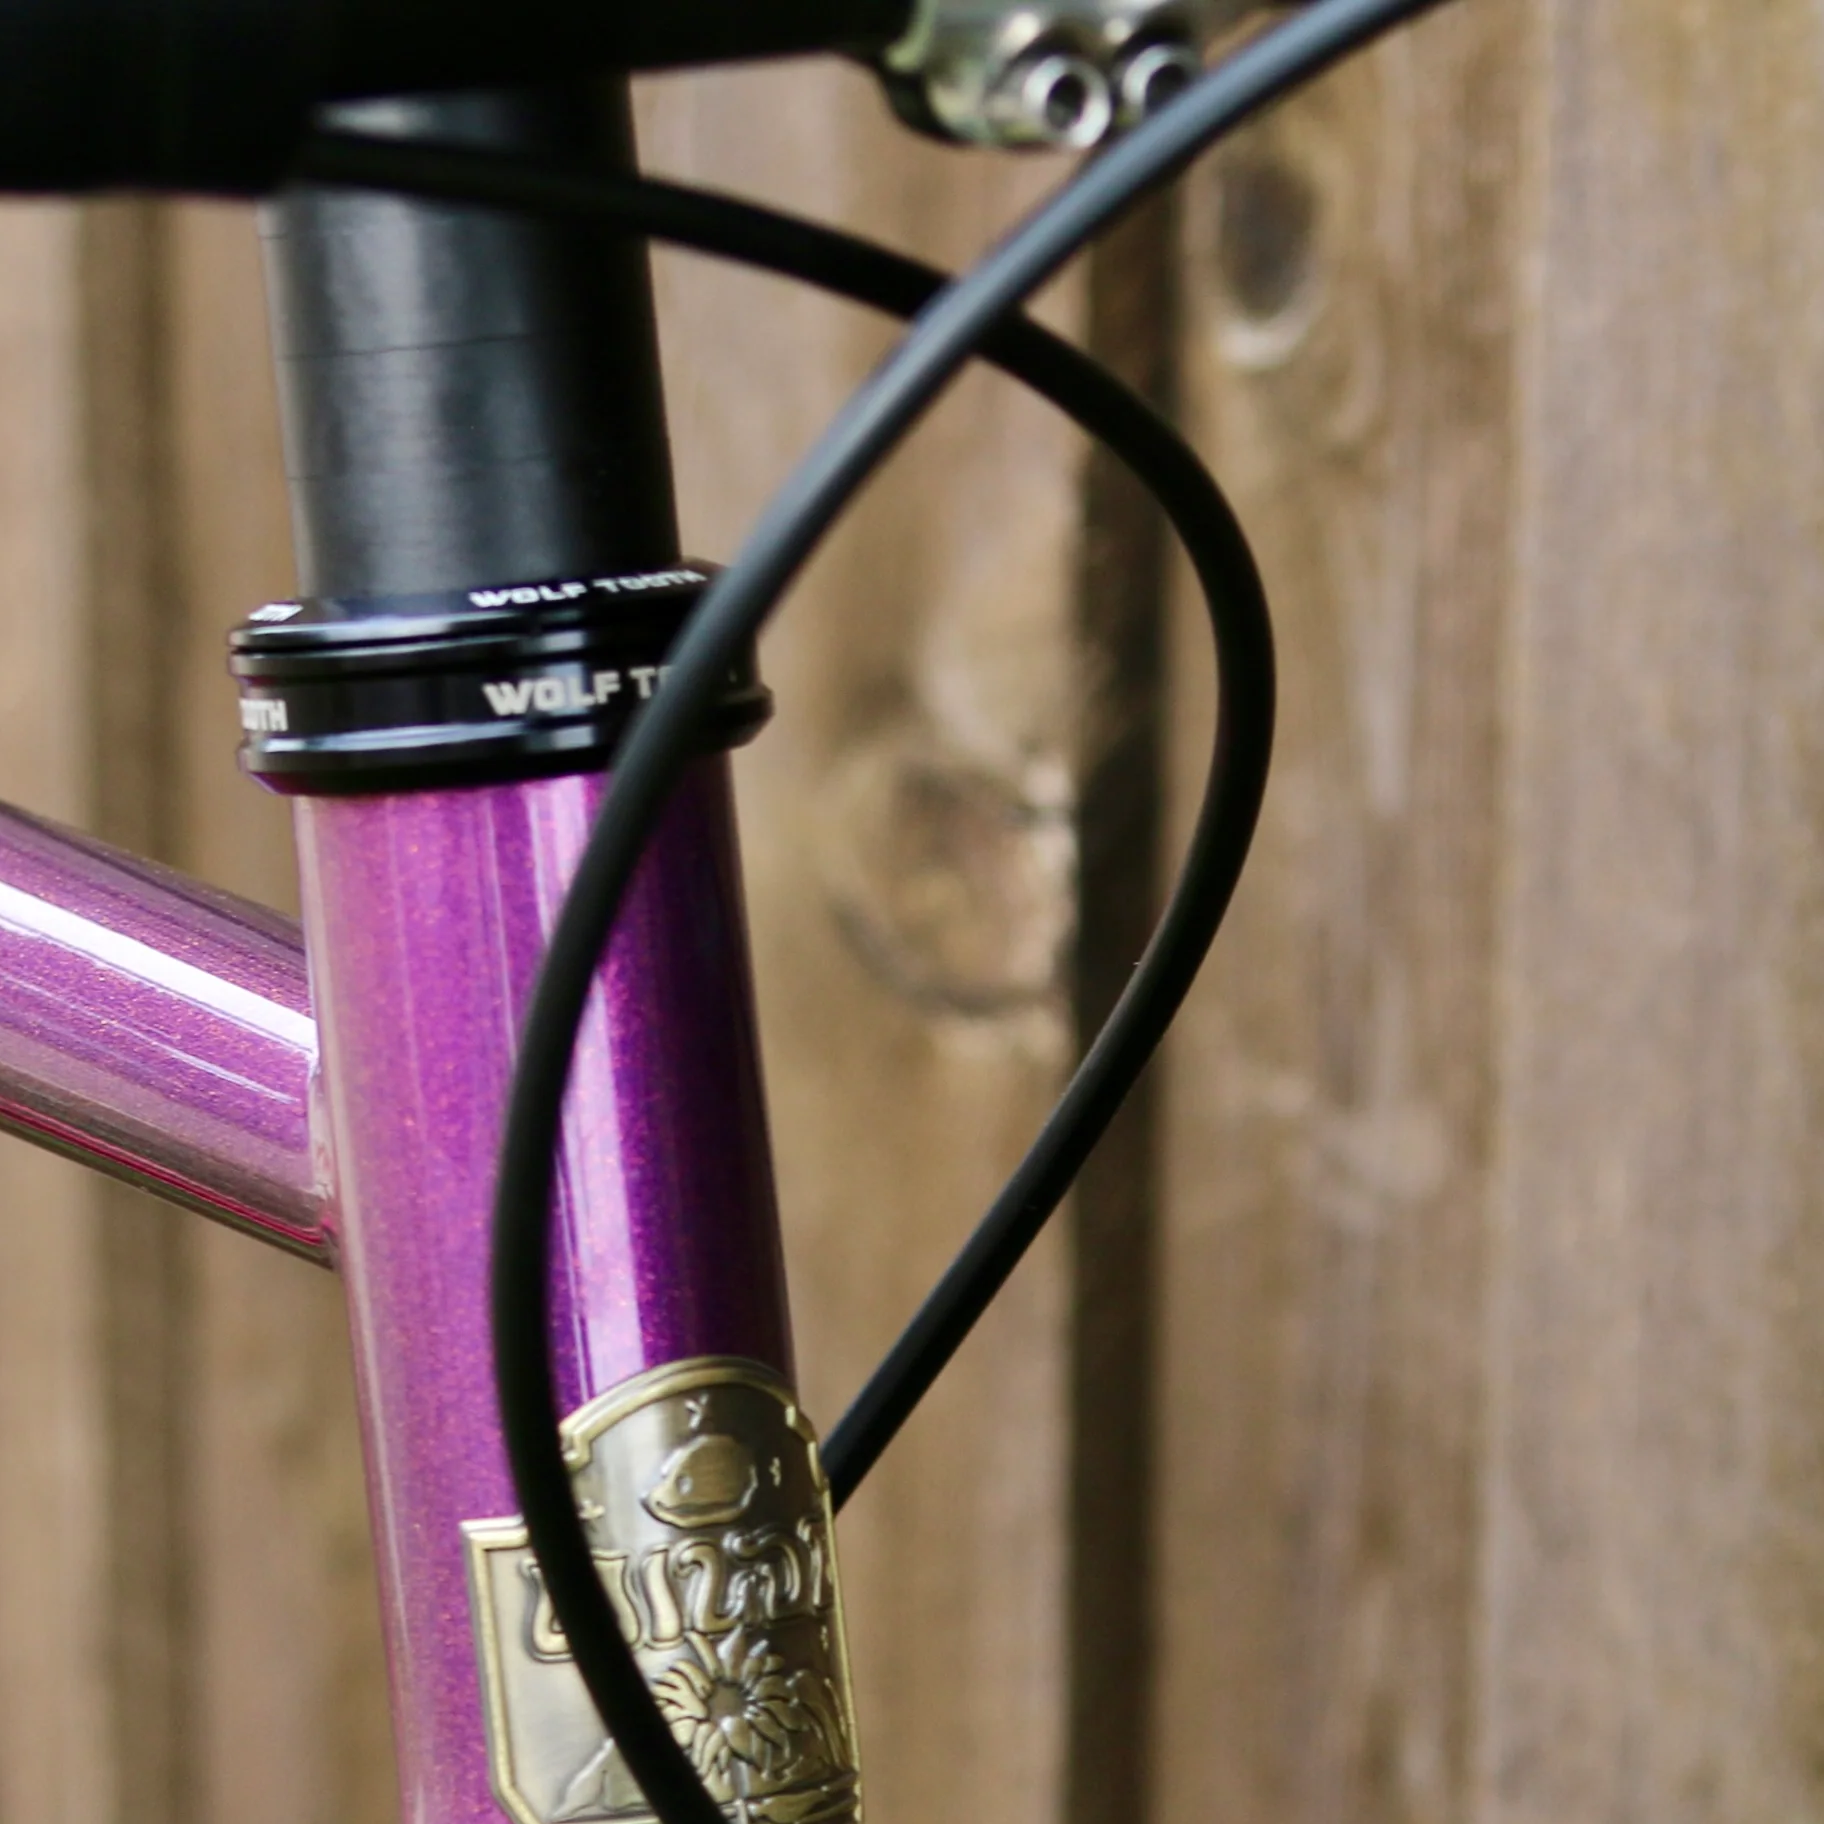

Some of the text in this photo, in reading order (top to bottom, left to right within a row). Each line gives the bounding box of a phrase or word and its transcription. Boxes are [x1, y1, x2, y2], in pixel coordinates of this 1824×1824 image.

[469, 569, 708, 608] WOLF TOOTH
[482, 670, 622, 716] WOLF
